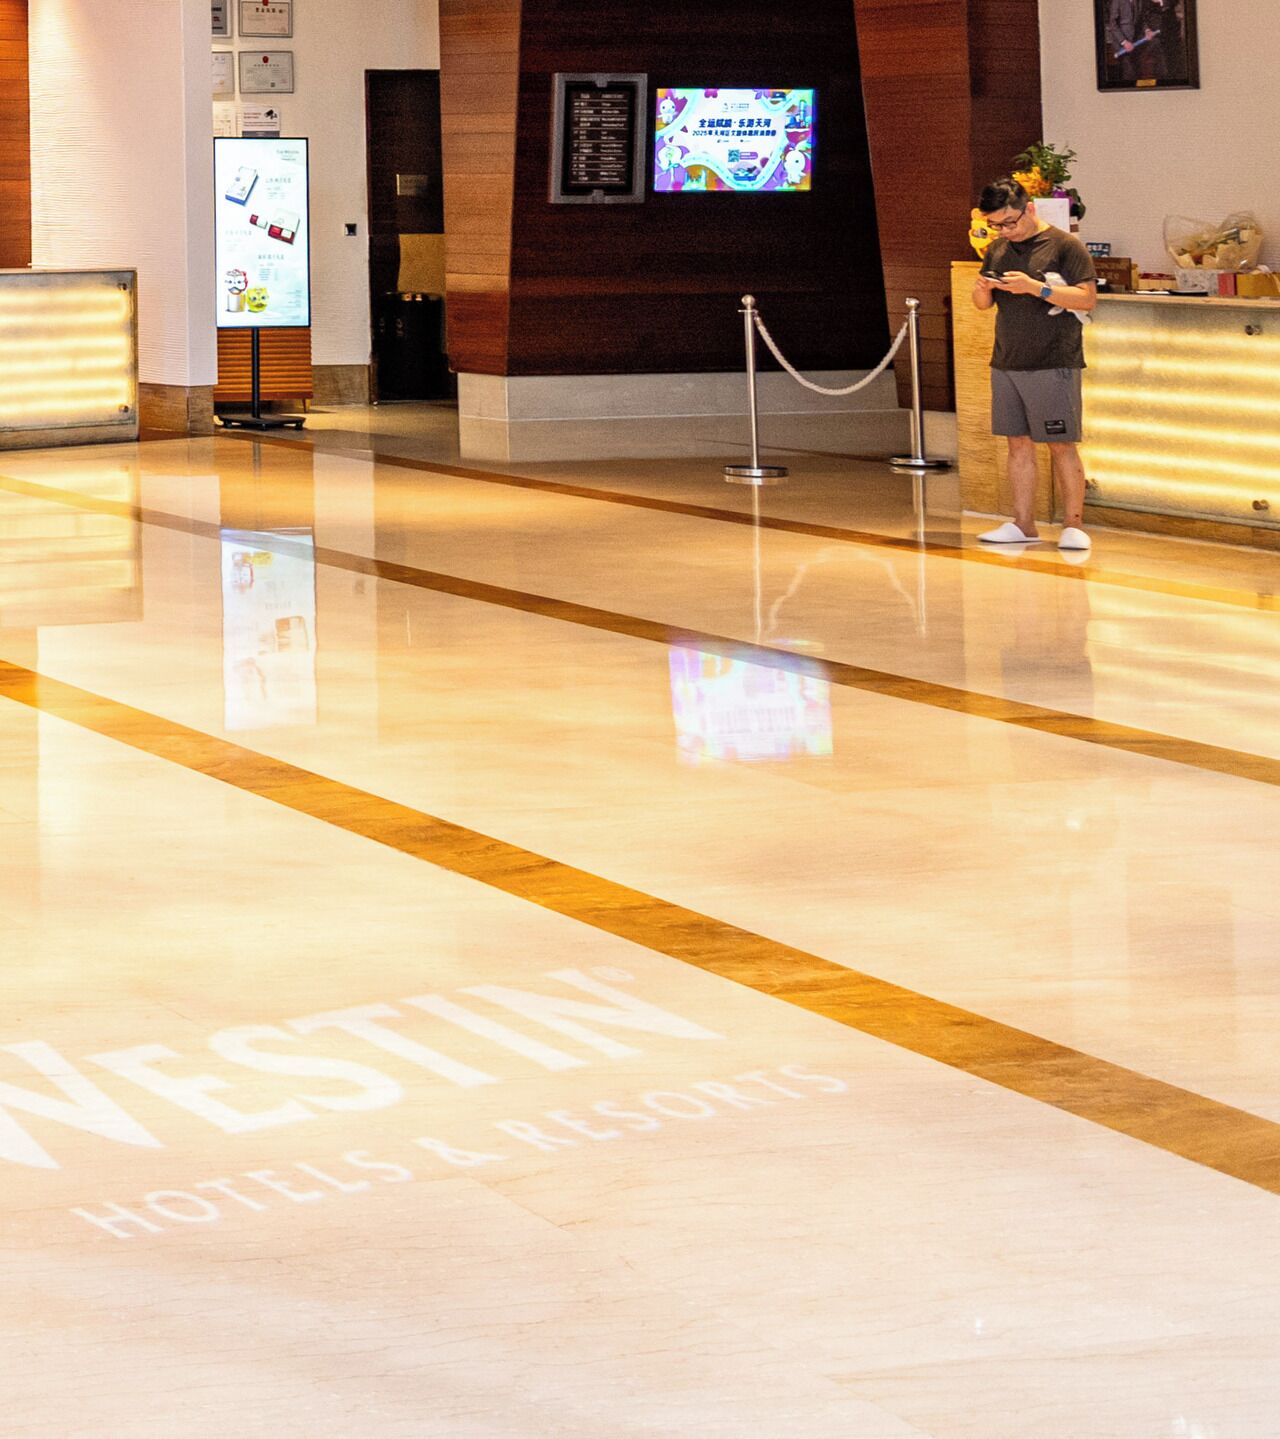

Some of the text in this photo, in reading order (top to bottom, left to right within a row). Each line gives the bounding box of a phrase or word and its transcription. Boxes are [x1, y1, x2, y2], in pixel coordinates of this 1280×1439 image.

[68, 1064, 848, 1239] HOTELS & RESORTS
